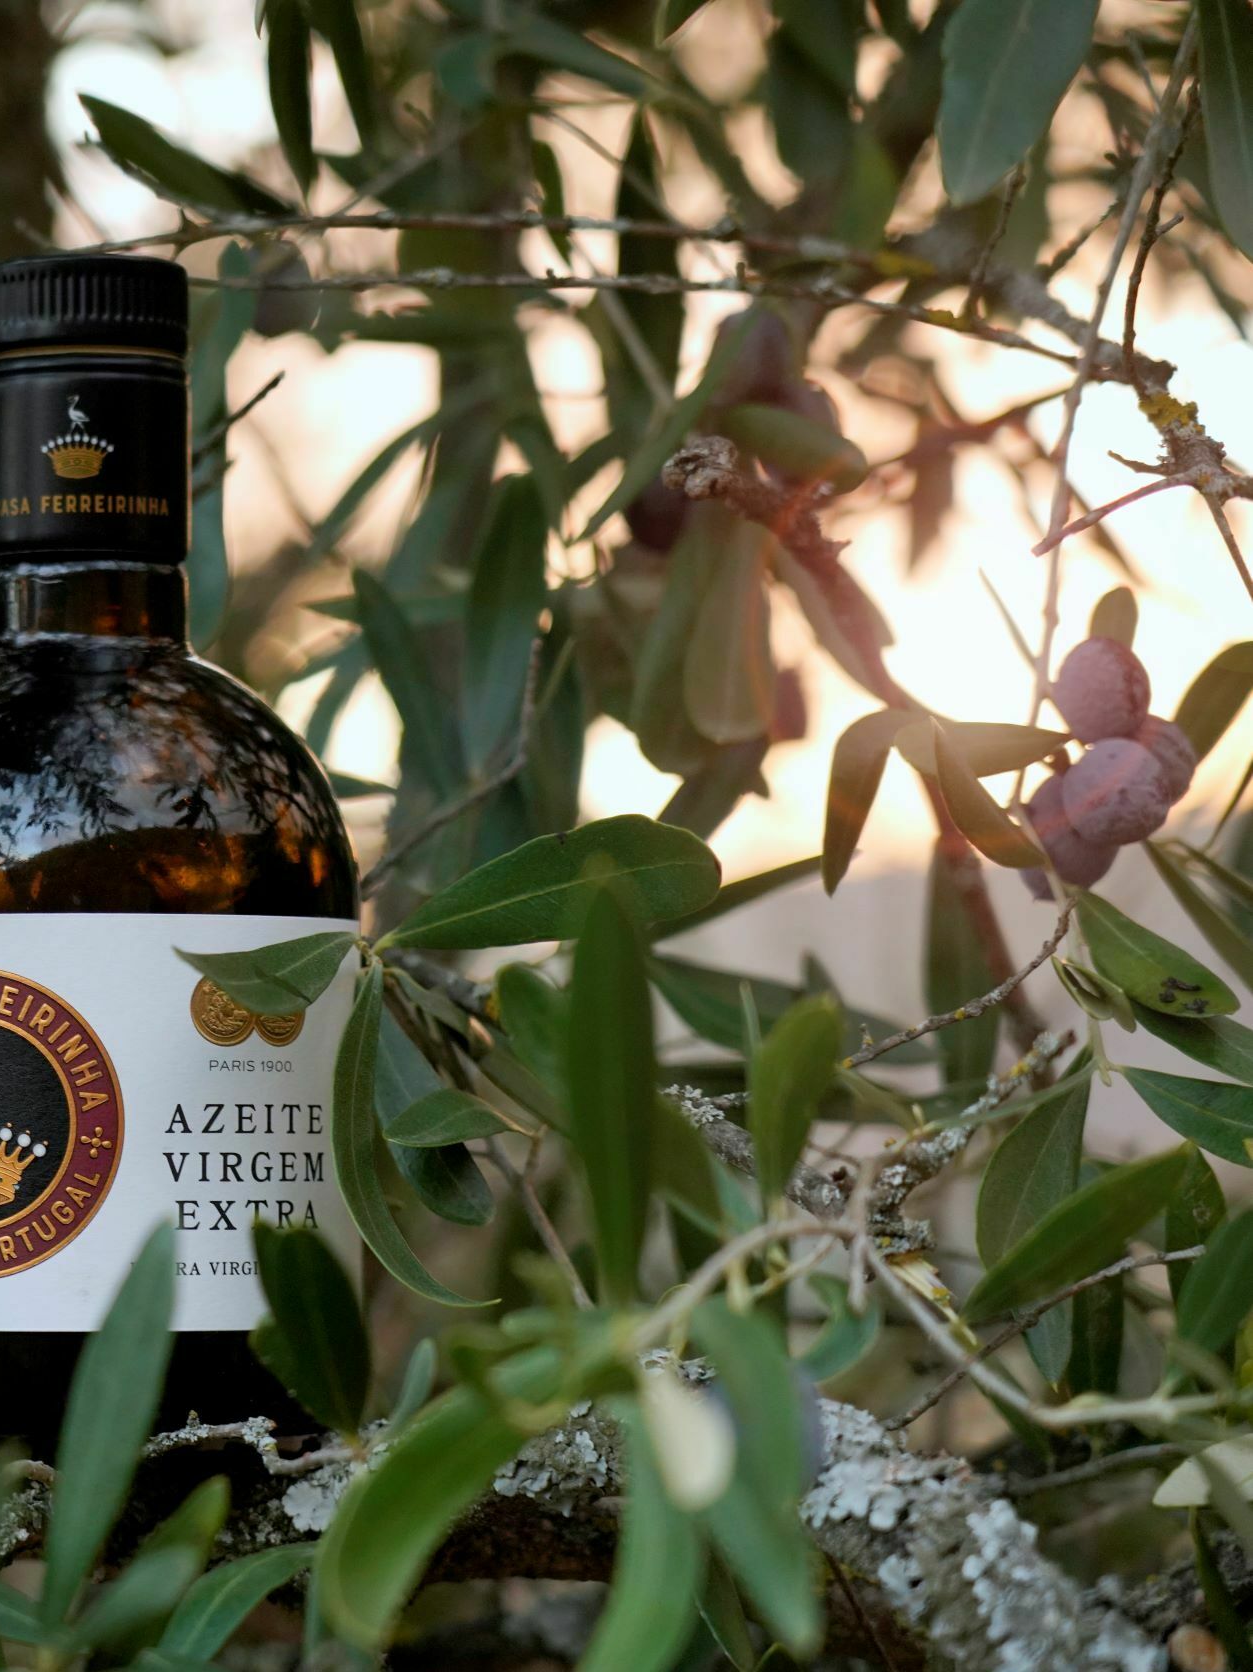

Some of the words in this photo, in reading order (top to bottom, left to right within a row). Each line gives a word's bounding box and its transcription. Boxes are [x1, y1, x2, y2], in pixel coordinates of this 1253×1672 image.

[40, 494, 169, 516] FERREIRINHA
[209, 1060, 255, 1072] PARIS
[164, 1103, 323, 1134] AZEITE
[162, 1152, 325, 1182] VIRGEM
[175, 1199, 319, 1231] EXTRA
[209, 1261, 259, 1276] VIRGI
